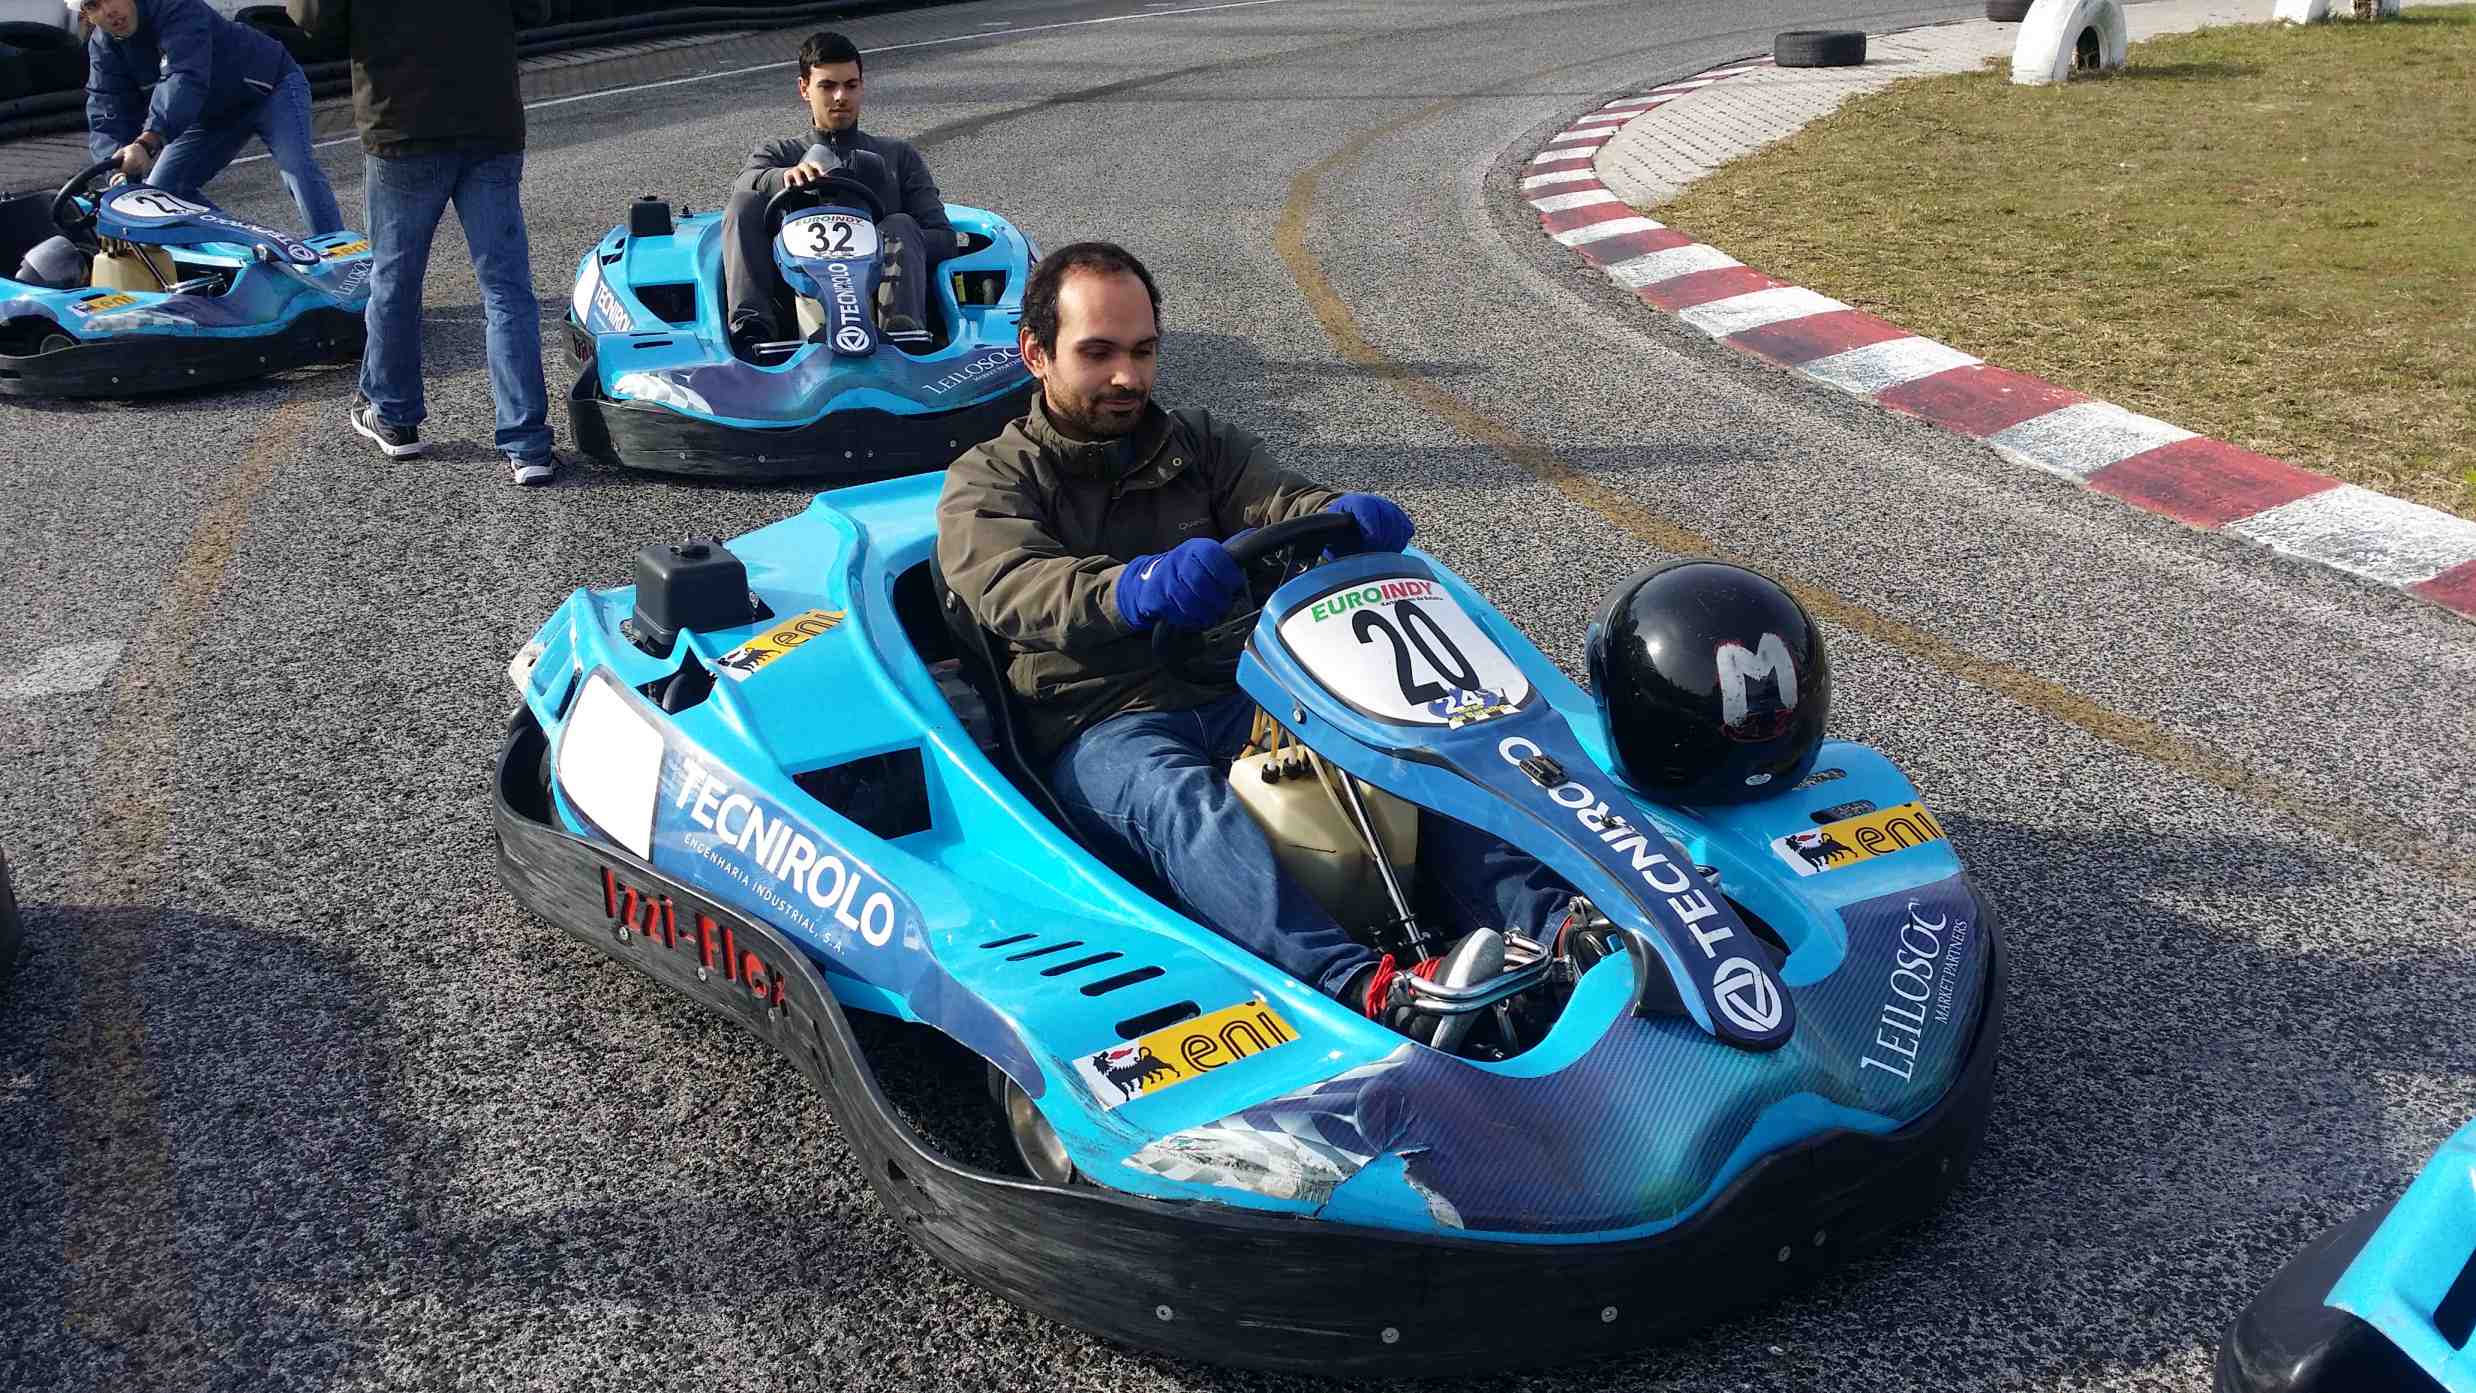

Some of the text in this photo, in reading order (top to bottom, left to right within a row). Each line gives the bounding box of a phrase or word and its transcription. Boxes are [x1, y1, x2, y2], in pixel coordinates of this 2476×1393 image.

[807, 222, 855, 252] 32
[773, 611, 844, 647] eni
[1311, 581, 1433, 623] EUROINDY
[1352, 600, 1480, 706] 20
[1715, 632, 1799, 730] M
[676, 757, 895, 948] TECNIROLO
[1499, 736, 1735, 960] TECNIROO
[1855, 803, 1943, 856] eni
[683, 833, 750, 887] ENGENHARIA
[752, 881, 819, 938] INDUSTRIAL,
[1861, 898, 1947, 1083] LEILOSOC
[1935, 919, 1968, 1025] MARKET PARTNERS
[1181, 1001, 1289, 1073] eni
